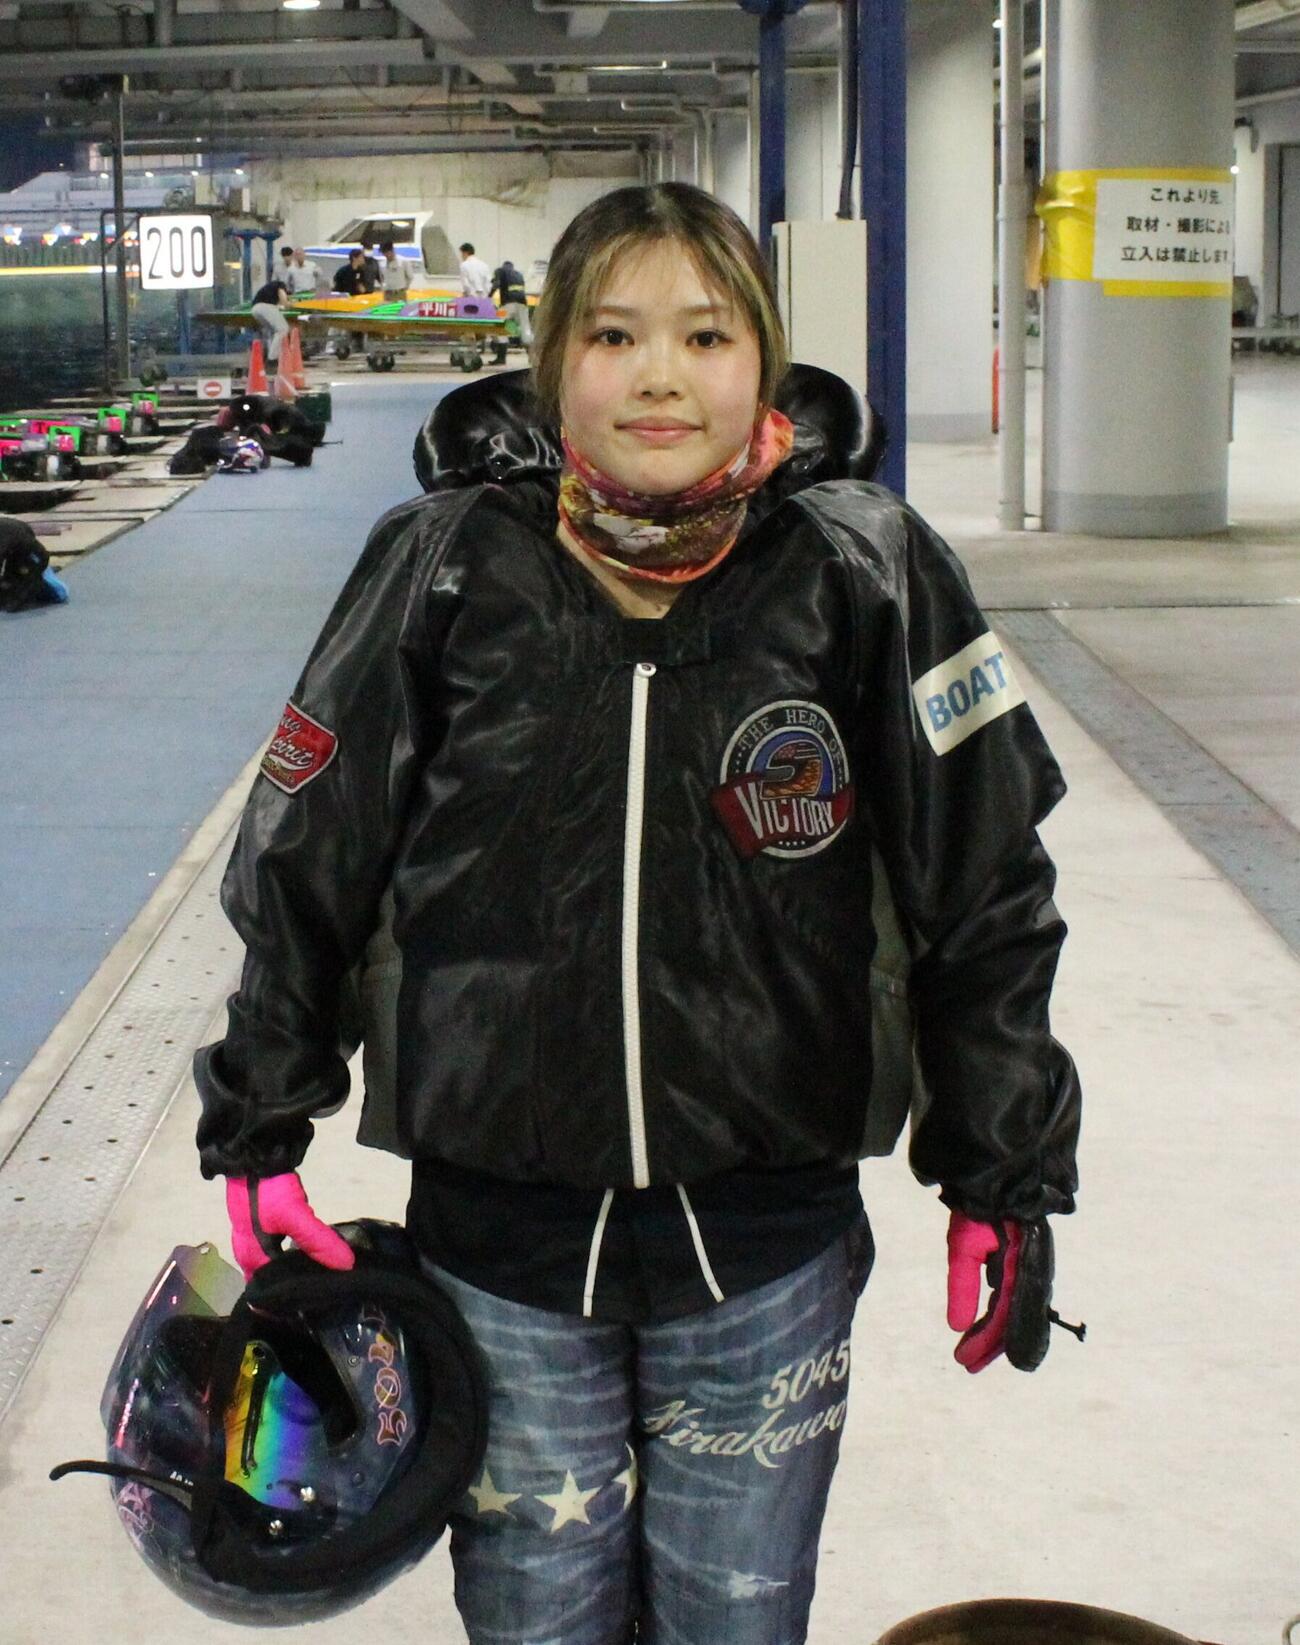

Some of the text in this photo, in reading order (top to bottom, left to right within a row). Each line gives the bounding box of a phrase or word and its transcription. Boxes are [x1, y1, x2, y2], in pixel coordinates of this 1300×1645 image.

[147, 226, 207, 279] 200
[926, 651, 1007, 733] BOAT
[737, 716, 774, 751] THE
[785, 708, 826, 733] HERO
[734, 782, 834, 840] VICTORY
[762, 1340, 850, 1410] 5045
